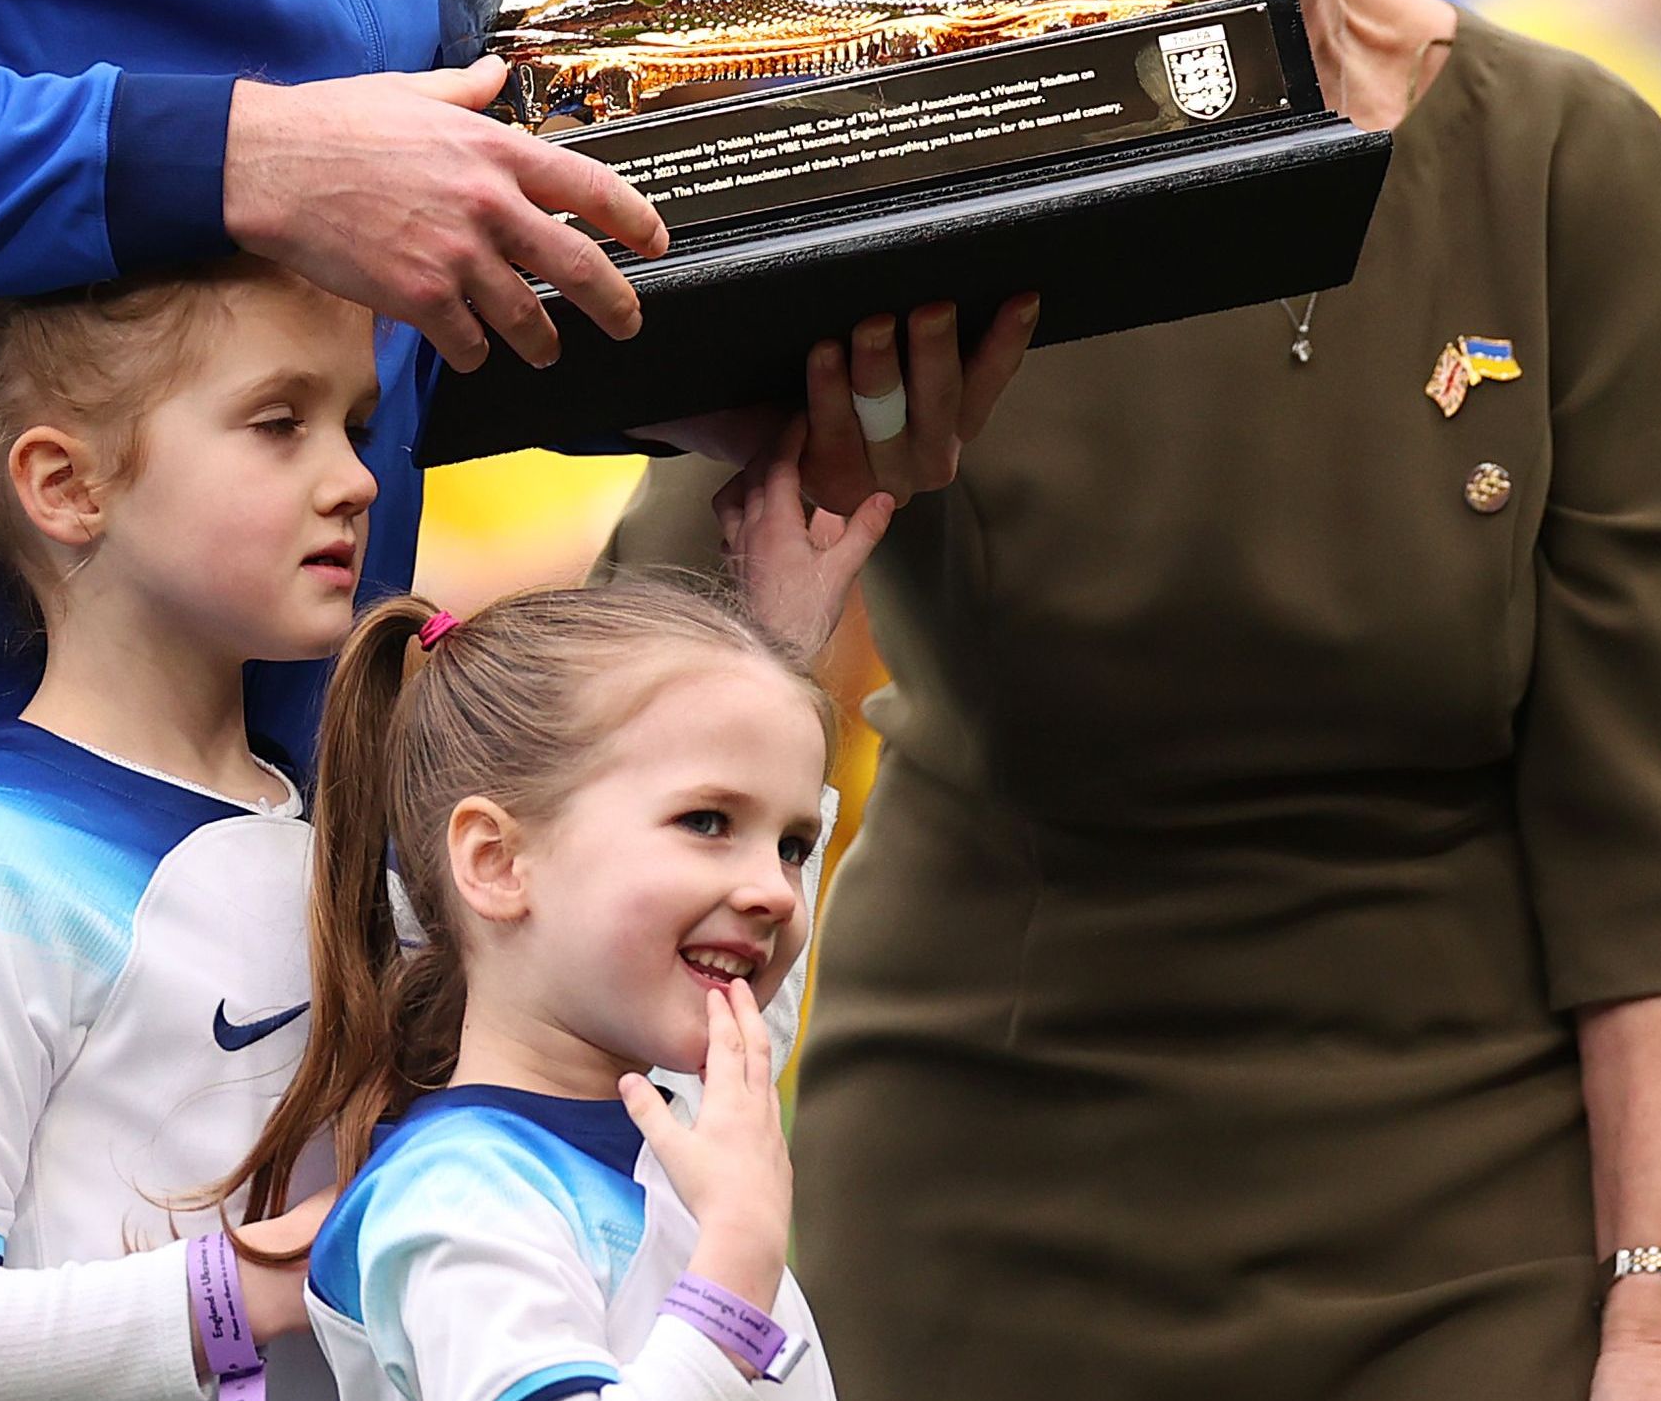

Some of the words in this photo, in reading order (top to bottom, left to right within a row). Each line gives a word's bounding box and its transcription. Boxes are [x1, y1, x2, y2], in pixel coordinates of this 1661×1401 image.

[632, 158, 653, 168] was
[654, 145, 703, 162] presented
[703, 144, 716, 156] by
[790, 123, 817, 137] MBE,
[817, 118, 845, 131] Chair
[846, 114, 858, 126] of
[858, 112, 879, 123] The
[880, 102, 920, 118] Football
[921, 95, 980, 111] Association,
[980, 90, 992, 100] at
[991, 81, 1040, 97] Wembley
[1040, 74, 1080, 88] Stadium
[1081, 71, 1095, 80] on
[646, 192, 672, 204] from
[672, 187, 694, 198] The
[694, 177, 734, 192] Football
[736, 166, 790, 187] Association
[792, 162, 811, 175] and
[812, 157, 841, 171] thank
[841, 155, 860, 168] you
[861, 150, 877, 161] for
[879, 140, 930, 156] everything
[930, 137, 949, 151] you
[950, 133, 974, 144] have
[975, 128, 1001, 139] done
[1001, 123, 1017, 133] for
[1018, 119, 1036, 130] the
[1037, 115, 1062, 127] team
[1063, 109, 1082, 122] and
[1083, 104, 1124, 118] country.
[680, 165, 693, 174] to
[694, 158, 720, 172] mark
[720, 153, 750, 166] Harry
[751, 148, 777, 160] Kane
[778, 140, 802, 155] MBE
[802, 134, 850, 150] becoming
[889, 118, 918, 133] men's
[919, 113, 956, 127] all-time
[956, 106, 992, 119] leading
[992, 96, 1046, 115] goalscorer.
[200, 1249, 211, 1286] Ukraine
[204, 1296, 224, 1339] England
